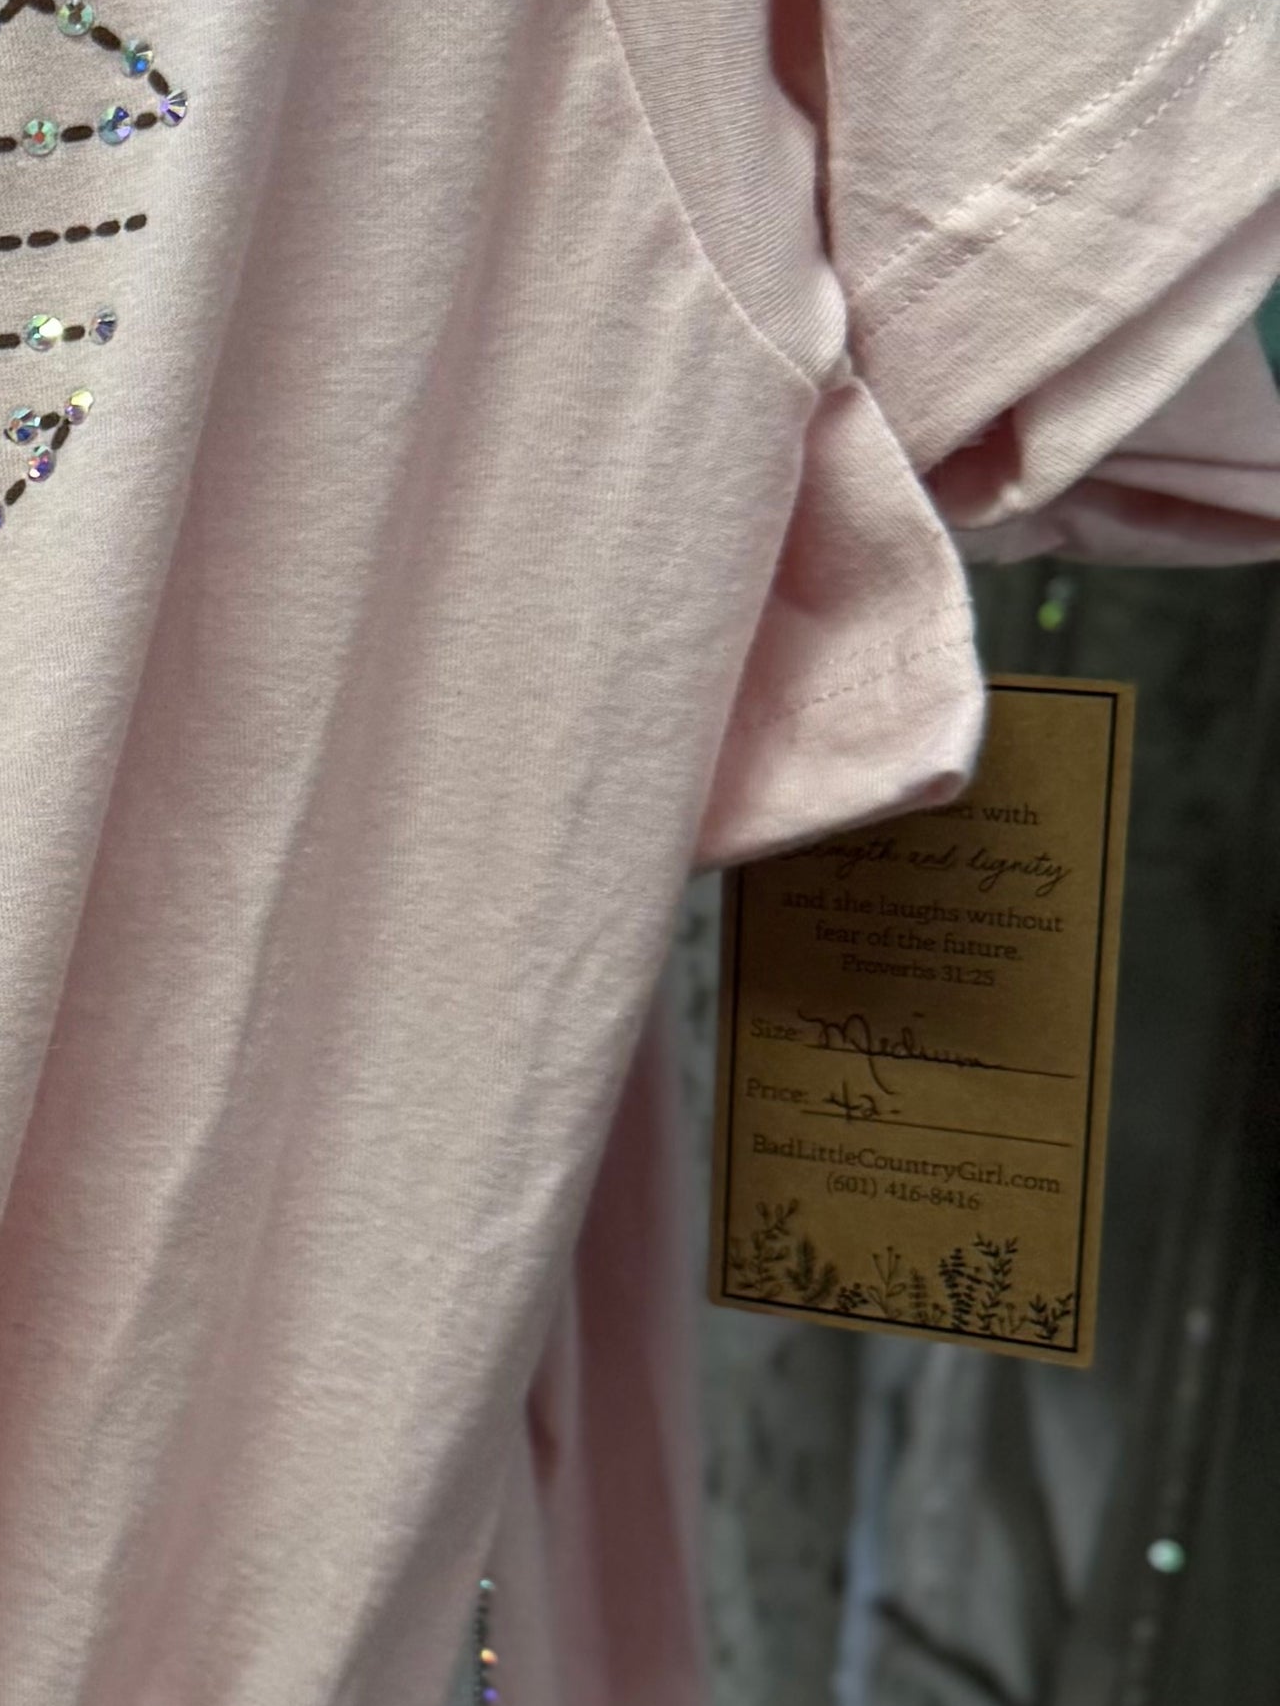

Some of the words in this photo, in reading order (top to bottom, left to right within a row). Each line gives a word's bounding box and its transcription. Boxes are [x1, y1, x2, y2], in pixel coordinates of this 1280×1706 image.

[982, 804, 1041, 826] with
[908, 845, 958, 871] and
[966, 848, 1071, 898] dignity
[781, 887, 825, 911] and
[832, 890, 873, 914] she
[880, 894, 959, 925] laughs
[966, 906, 1065, 933] without
[814, 920, 860, 945] fear
[866, 925, 894, 949] of
[897, 929, 937, 952] the
[842, 954, 936, 981] Proverbs
[941, 965, 995, 988] 31:25
[752, 1133, 1062, 1195] BadLittleCountryGirl.com
[826, 1172, 878, 1200] (601)
[884, 1181, 982, 1212] 416-8416
